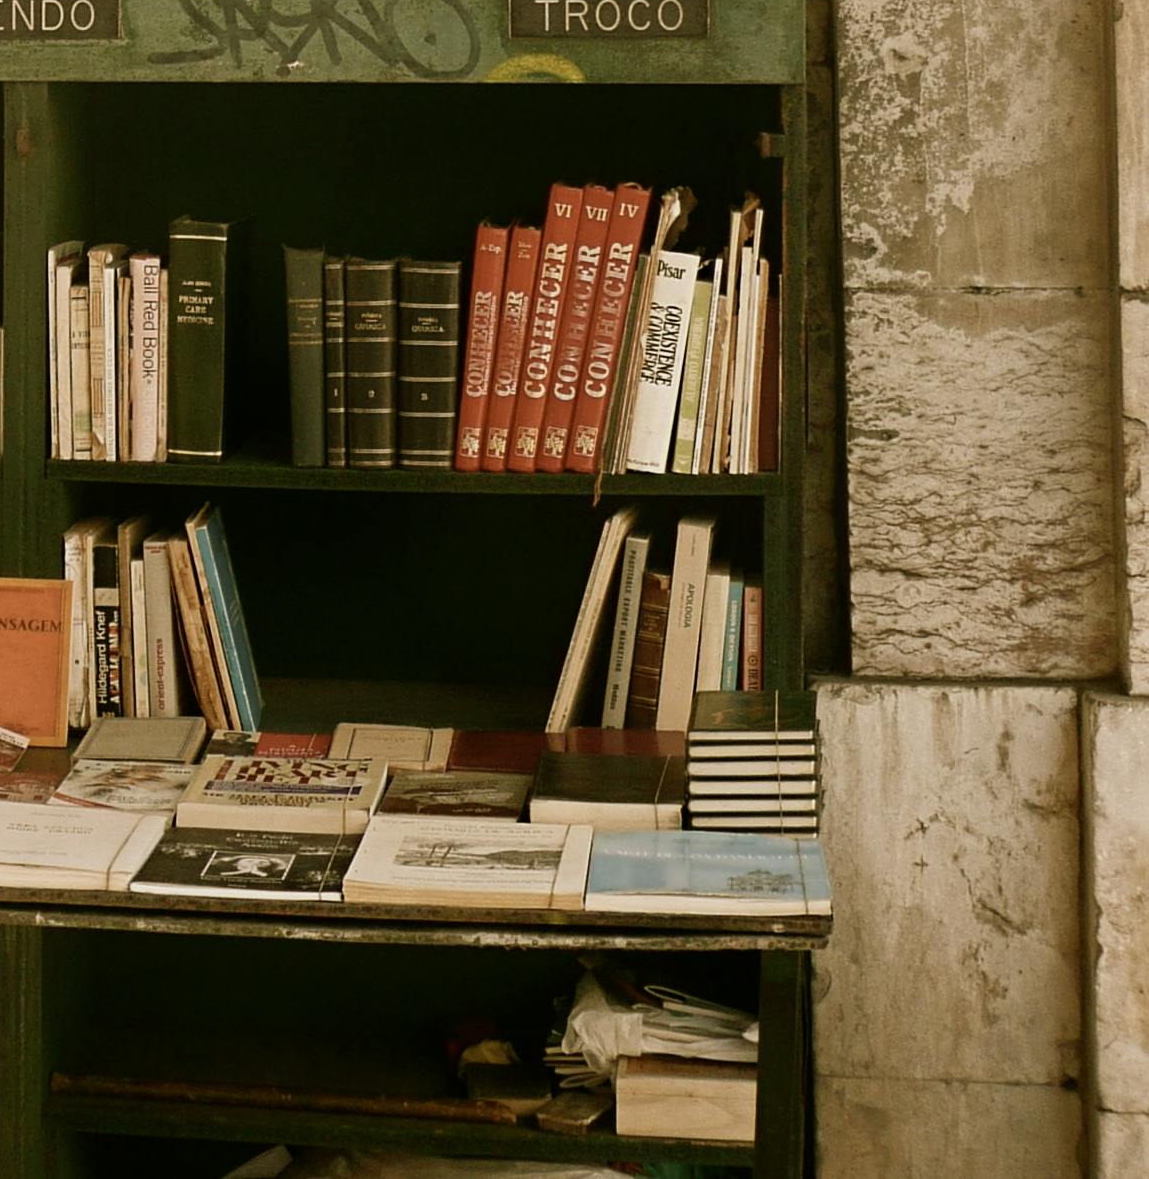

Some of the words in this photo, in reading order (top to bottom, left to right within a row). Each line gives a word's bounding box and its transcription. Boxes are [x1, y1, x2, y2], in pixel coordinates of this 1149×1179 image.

[554, 203, 573, 218] VI
[585, 206, 609, 221] VII
[619, 203, 639, 218] IV
[143, 264, 159, 294] Ball
[657, 259, 687, 280] Pisar
[143, 300, 159, 331] Red
[524, 242, 568, 399] CONHECER
[553, 244, 601, 401] CONHECER
[584, 242, 634, 399] CONHECER
[466, 290, 493, 398] CONHECER
[641, 317, 661, 385] COMMERCE
[655, 305, 682, 387] COEXISTENCE
[96, 610, 106, 640] Knef
[684, 583, 696, 629] APOLOGIA
[96, 645, 109, 704] Hildegard
